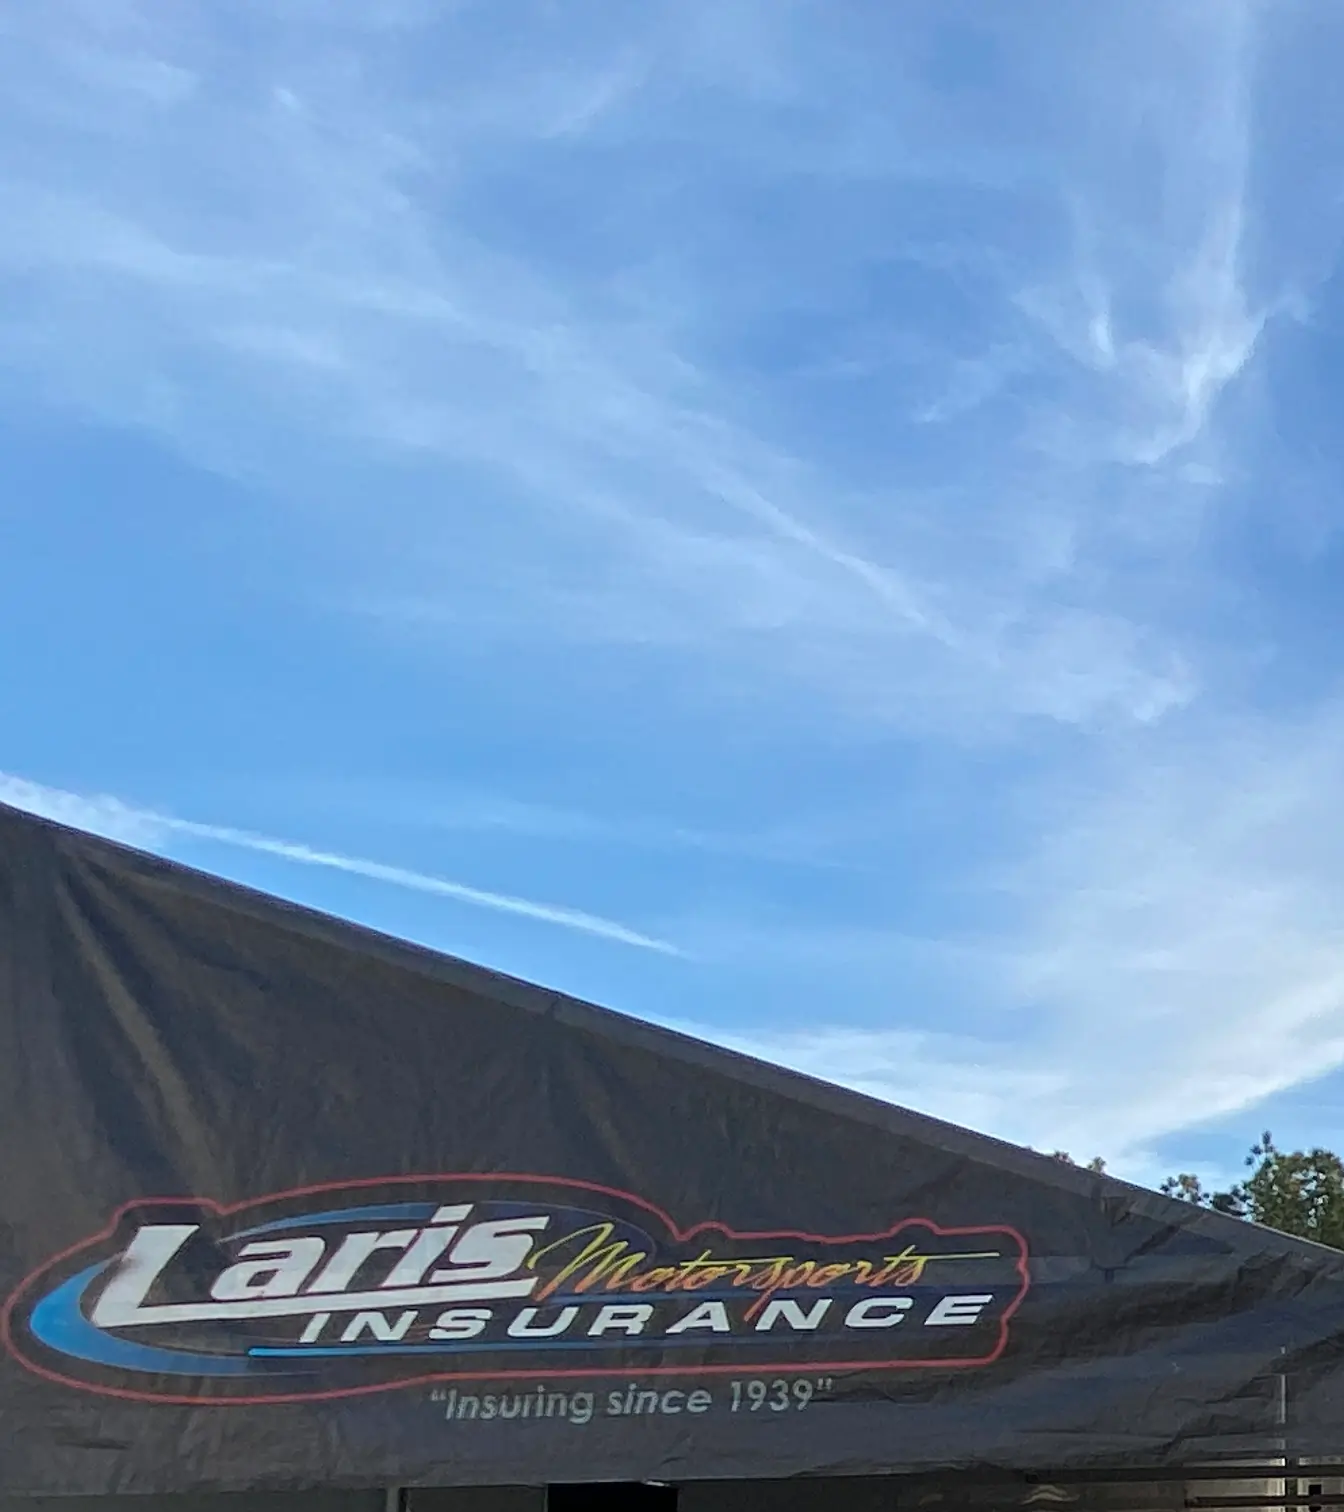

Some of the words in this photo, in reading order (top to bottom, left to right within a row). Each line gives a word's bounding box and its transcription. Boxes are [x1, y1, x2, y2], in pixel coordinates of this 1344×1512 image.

[93, 1204, 550, 1328] Laris
[527, 1222, 1000, 1322] Motorsports
[299, 1294, 994, 1344] INSURANCE
[430, 1384, 595, 1425] "Insuring
[606, 1382, 713, 1415] since
[729, 1377, 834, 1413] 1939"
